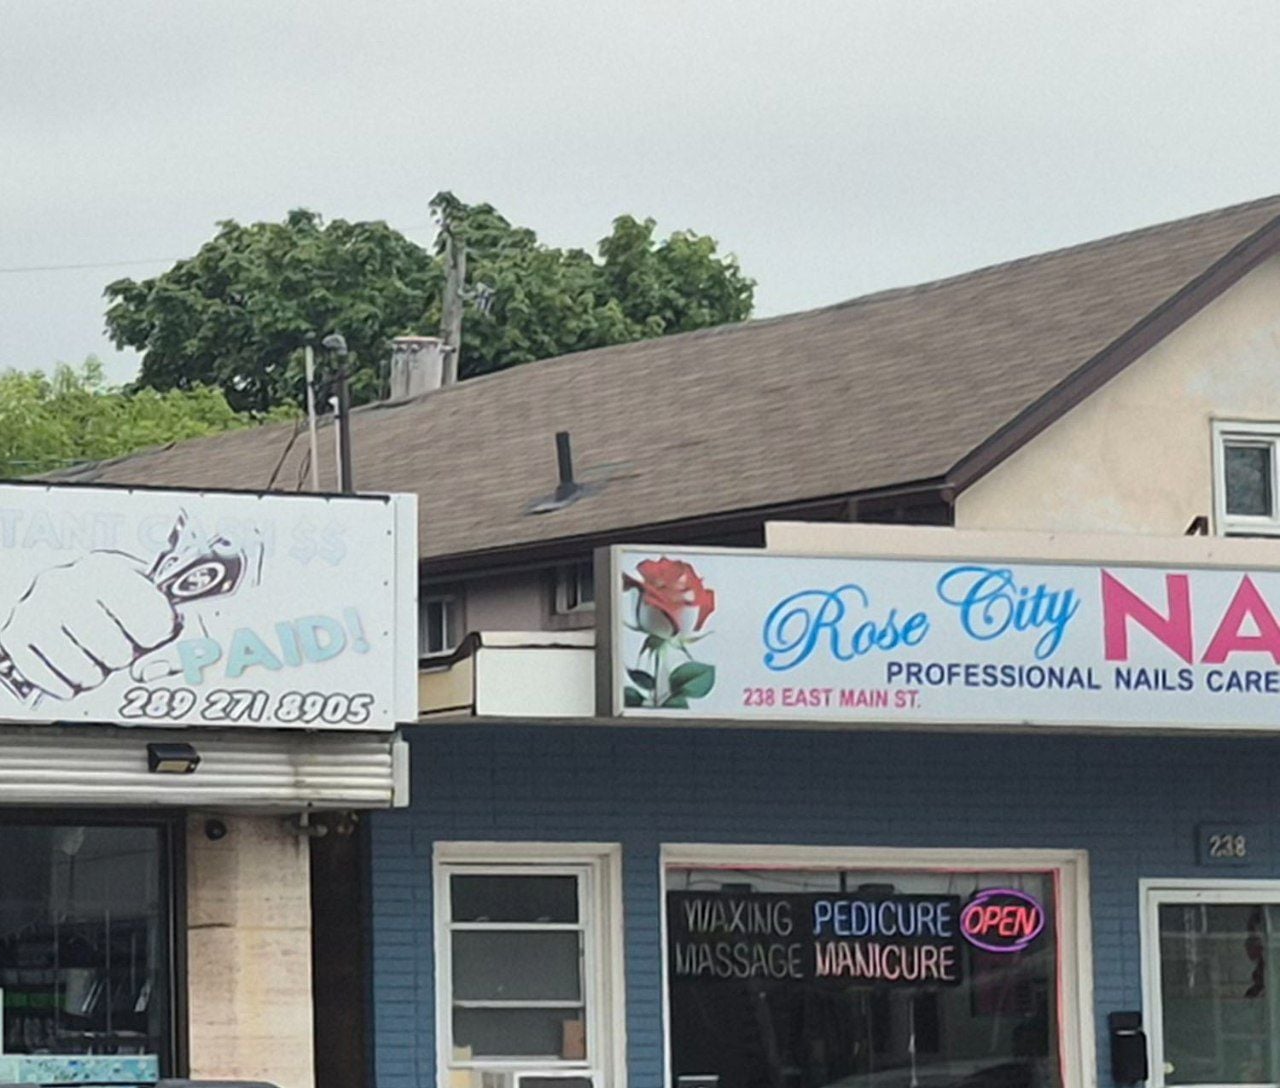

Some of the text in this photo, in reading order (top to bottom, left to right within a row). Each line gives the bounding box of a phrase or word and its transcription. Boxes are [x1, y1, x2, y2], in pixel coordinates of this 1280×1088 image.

[763, 584, 931, 672] Rose
[937, 565, 1082, 660] City
[177, 607, 372, 686] PAID!
[886, 662, 1280, 694] PROFESSIONAL NAILS CARE
[119, 688, 374, 723] 289 271 8905
[742, 688, 922, 709] 238 EAST MAIN ST.
[1209, 835, 1246, 857] 238
[684, 900, 952, 937] WAXING PEDICURE
[962, 906, 1035, 938] OPEN
[676, 943, 955, 980] MASSAGE MANICURE
